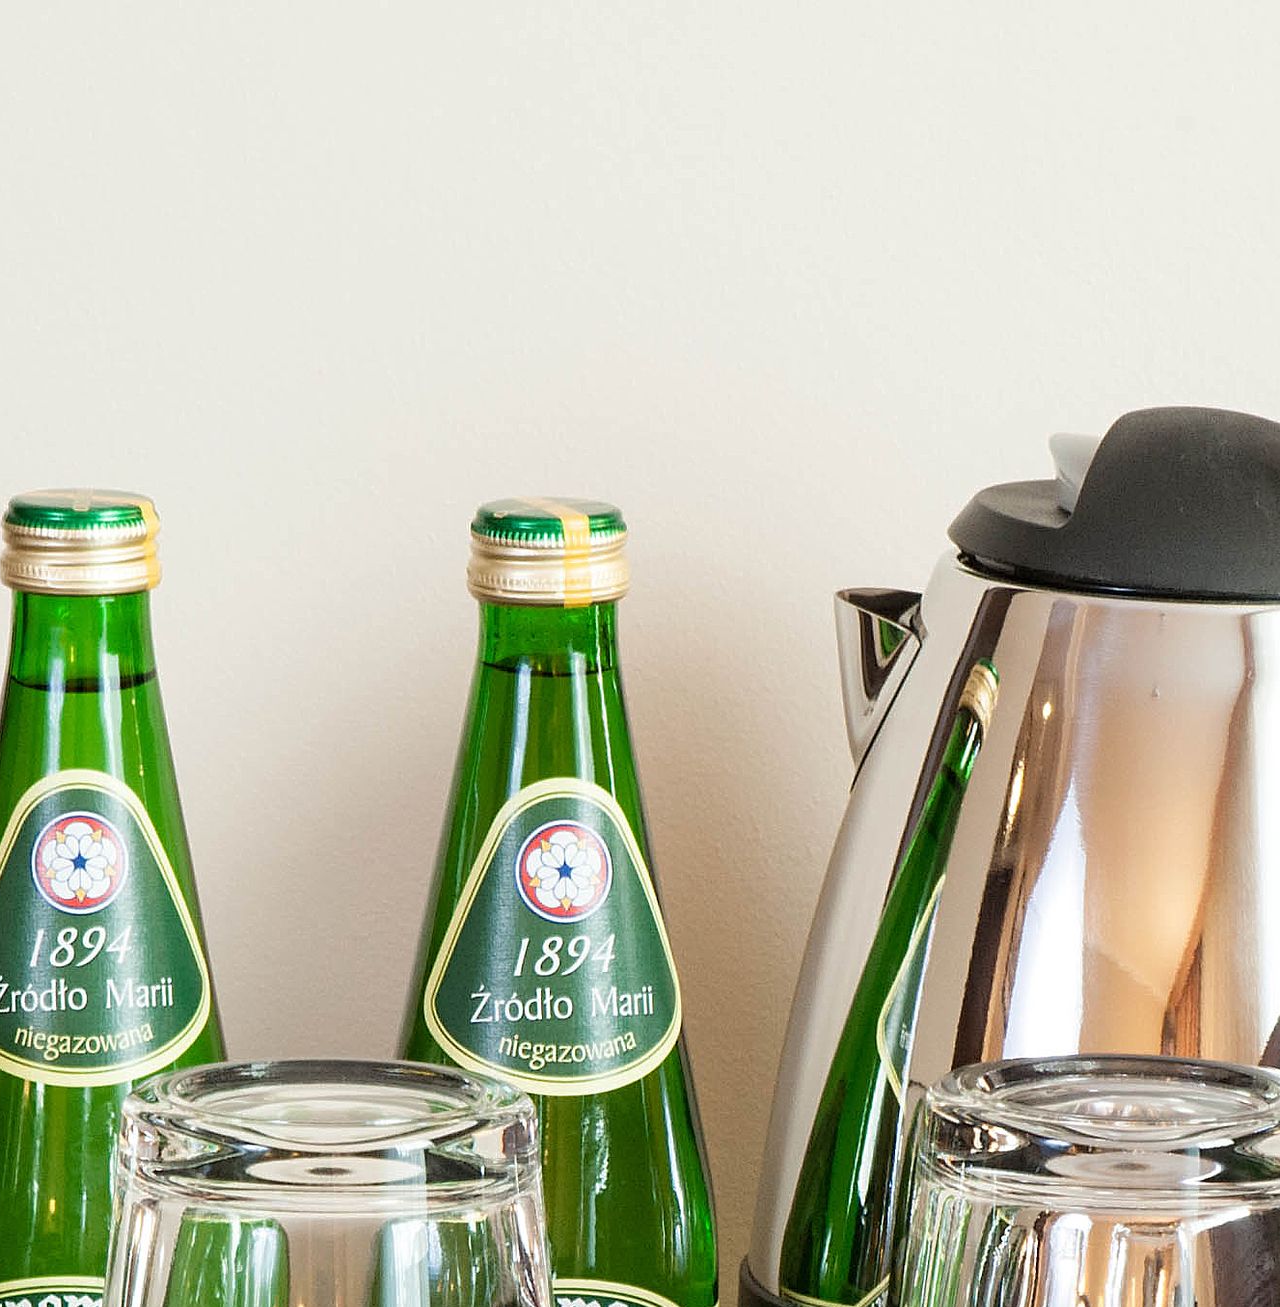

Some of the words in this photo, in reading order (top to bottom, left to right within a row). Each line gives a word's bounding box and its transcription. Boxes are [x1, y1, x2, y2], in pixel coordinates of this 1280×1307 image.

[30, 925, 133, 968] 1894
[513, 933, 616, 977] 1894
[106, 976, 173, 1009] Marii
[470, 985, 573, 1024] Źródło
[591, 985, 654, 1017] Marii
[15, 1022, 154, 1061] niegazowana
[498, 1031, 637, 1071] niegazowana
